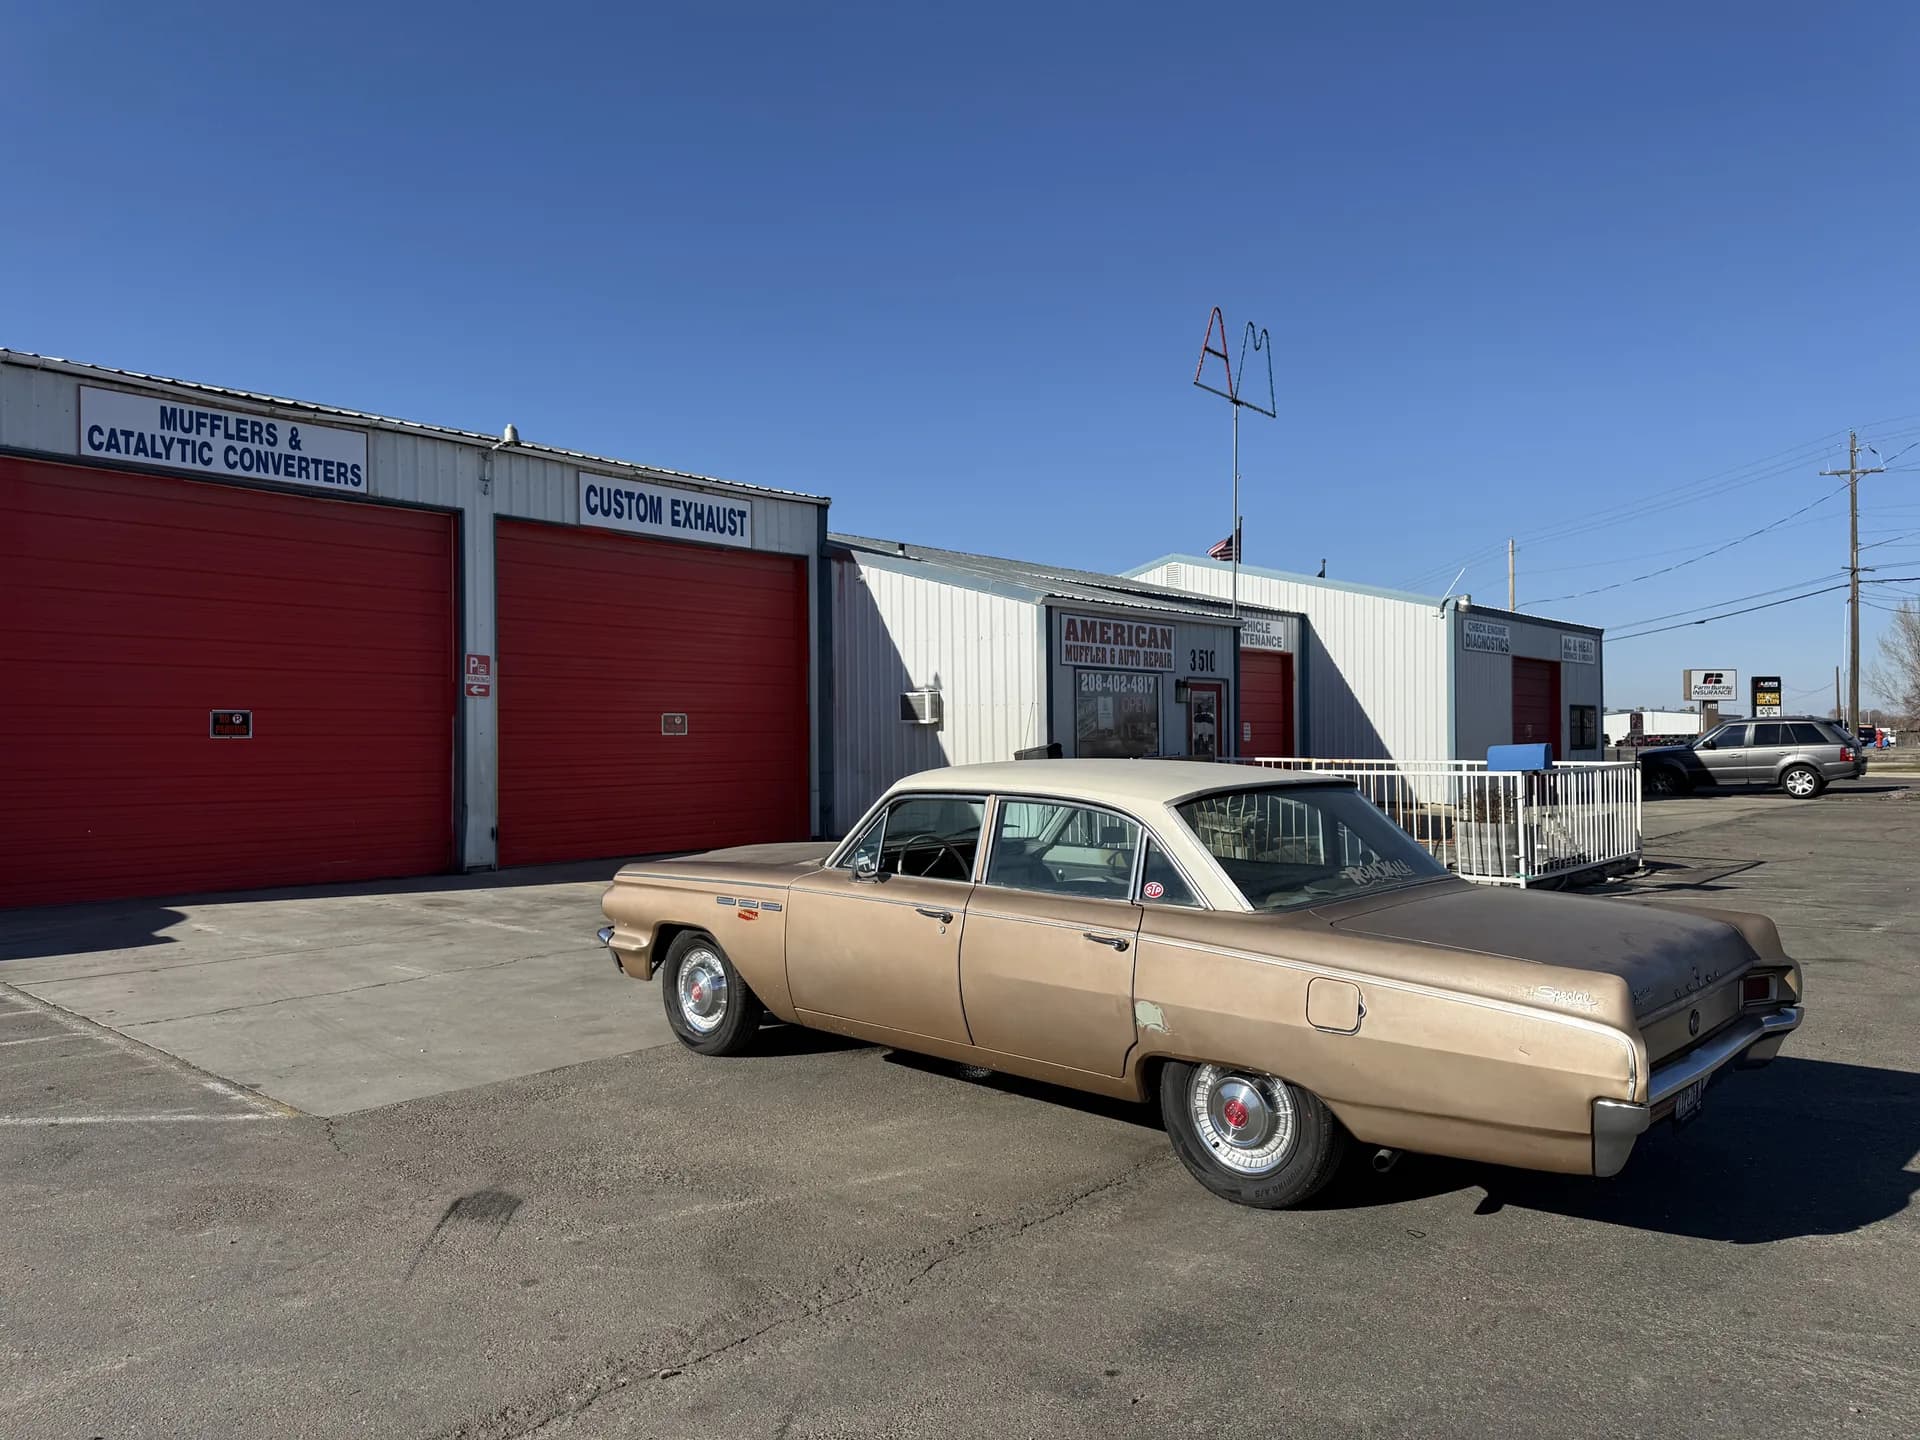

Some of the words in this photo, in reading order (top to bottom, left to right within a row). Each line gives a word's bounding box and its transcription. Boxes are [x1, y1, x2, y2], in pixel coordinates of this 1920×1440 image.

[160, 405, 278, 447] MUFFLERS
[288, 426, 302, 451] &
[87, 425, 213, 466] CATALYTIC
[224, 445, 362, 487] CONVERTERS
[585, 484, 662, 525] CUSTOM
[670, 498, 747, 537] EXHAUST
[1064, 618, 1173, 650] AMERICAN
[1241, 620, 1271, 634] EHICLE
[1468, 622, 1486, 633] CHECK
[1240, 631, 1282, 648] NTENANCE
[1465, 633, 1509, 653] DIAGNOSTICS
[1563, 638, 1572, 651] AC
[1578, 639, 1593, 653] HEAT
[1064, 644, 1107, 665] MUFFLER
[1109, 647, 1116, 665] &
[1118, 648, 1140, 667] AUTO
[1143, 650, 1173, 669] REPAIR
[1190, 649, 1216, 673] 3510
[1081, 673, 1155, 693] 208-402-4817
[1146, 884, 1161, 896] STP
[1534, 985, 1599, 1006] Special
